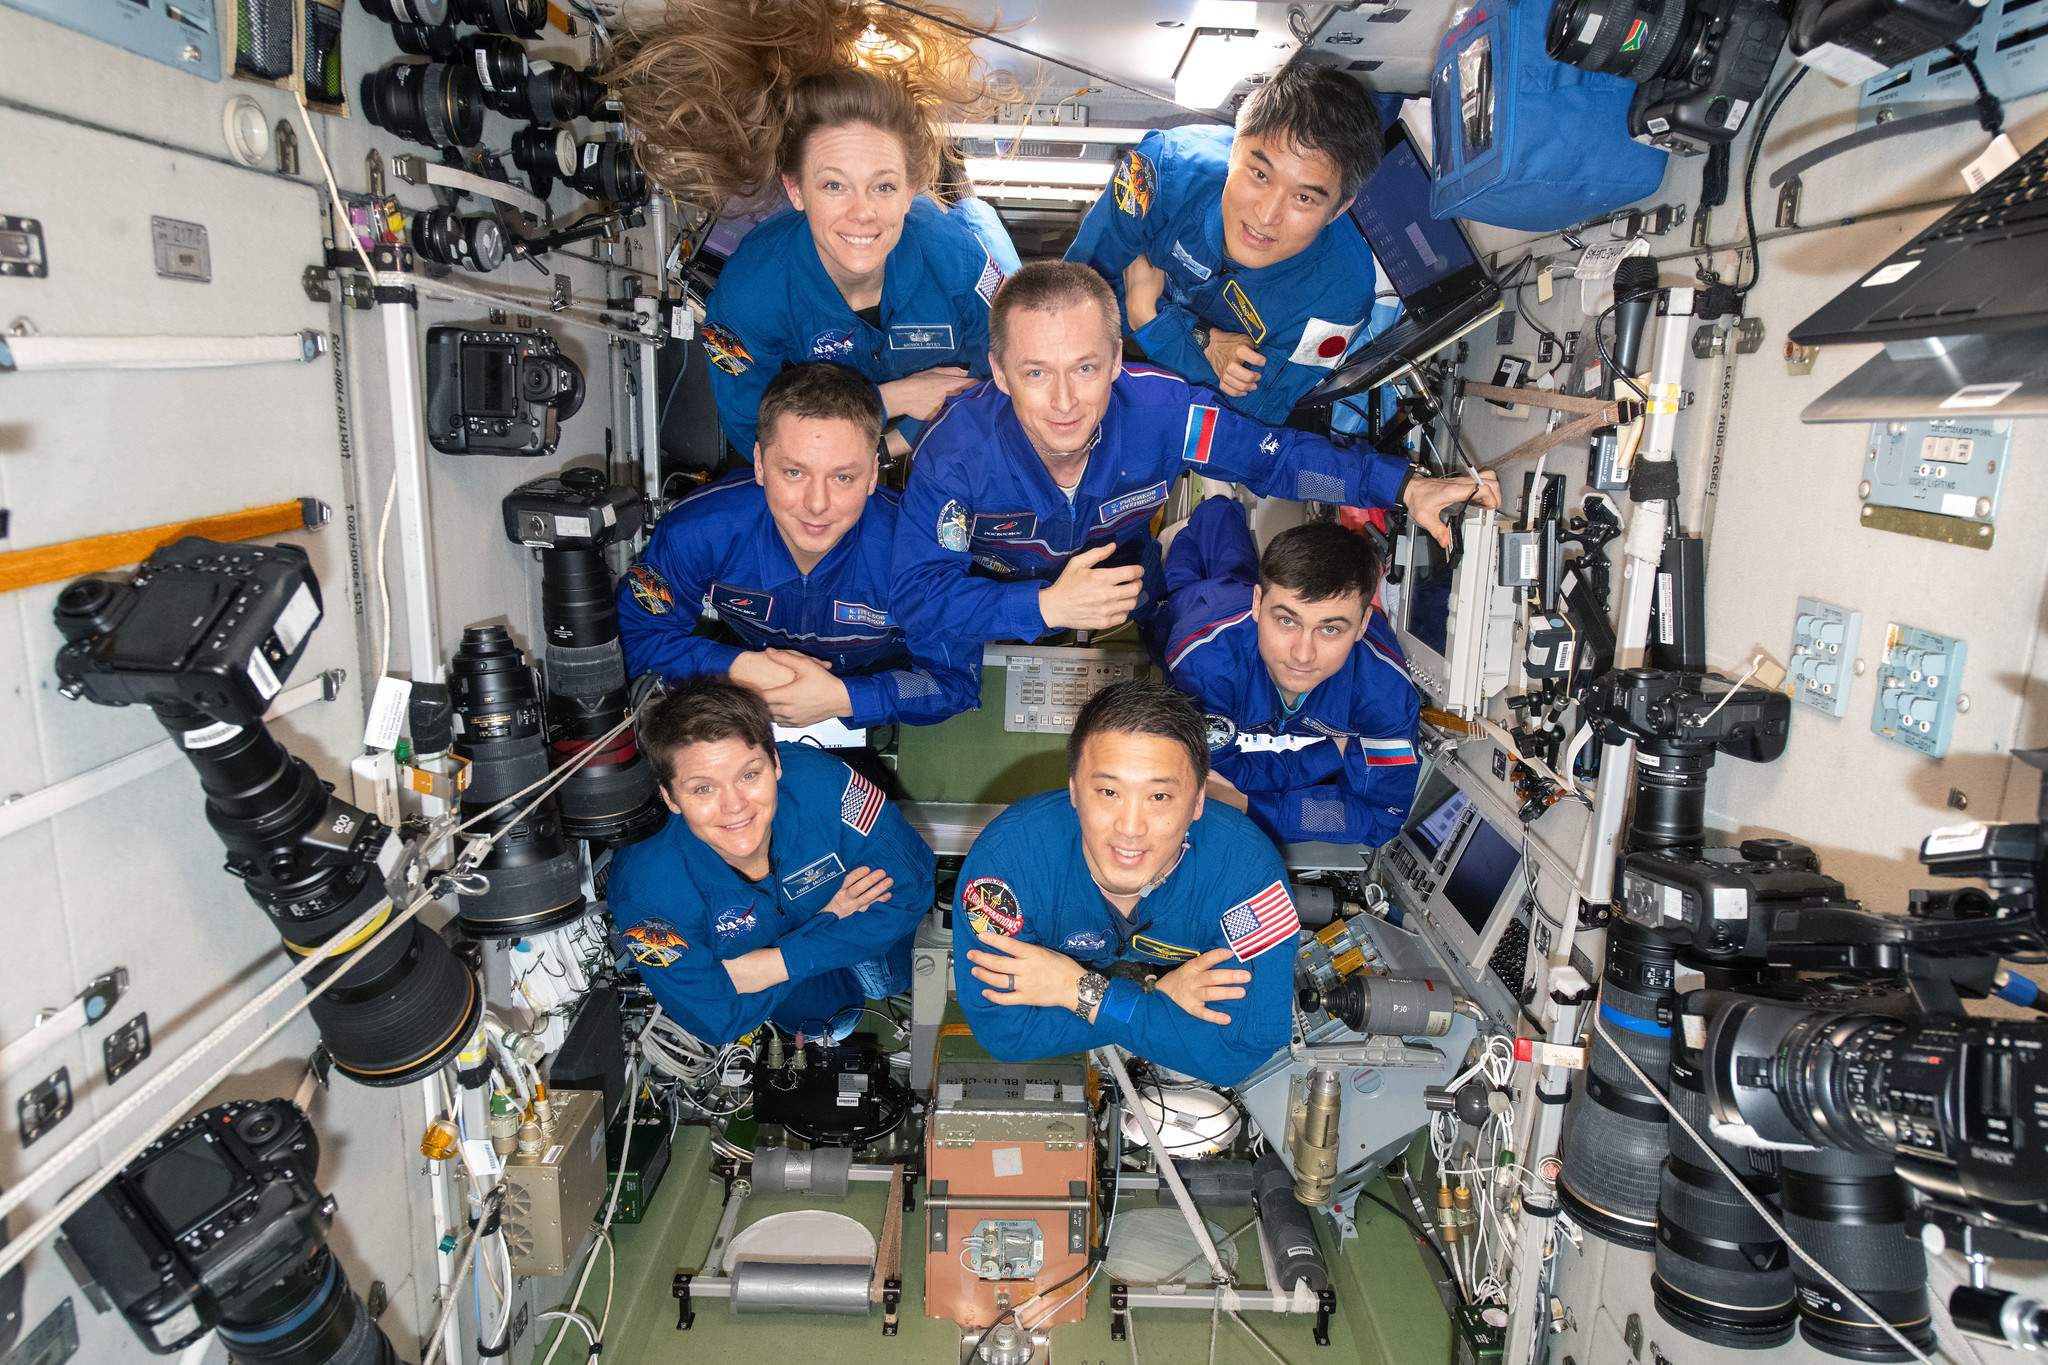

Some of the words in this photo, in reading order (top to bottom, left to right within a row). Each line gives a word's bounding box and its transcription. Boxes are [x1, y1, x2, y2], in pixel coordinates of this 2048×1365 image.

[813, 339, 854, 355] NASA
[857, 614, 886, 626] PESKOV
[332, 814, 351, 834] 800
[343, 821, 356, 834] mm
[964, 883, 983, 907] FLIGHT
[983, 905, 1021, 933] OPERATIONS
[715, 914, 756, 933] NASA
